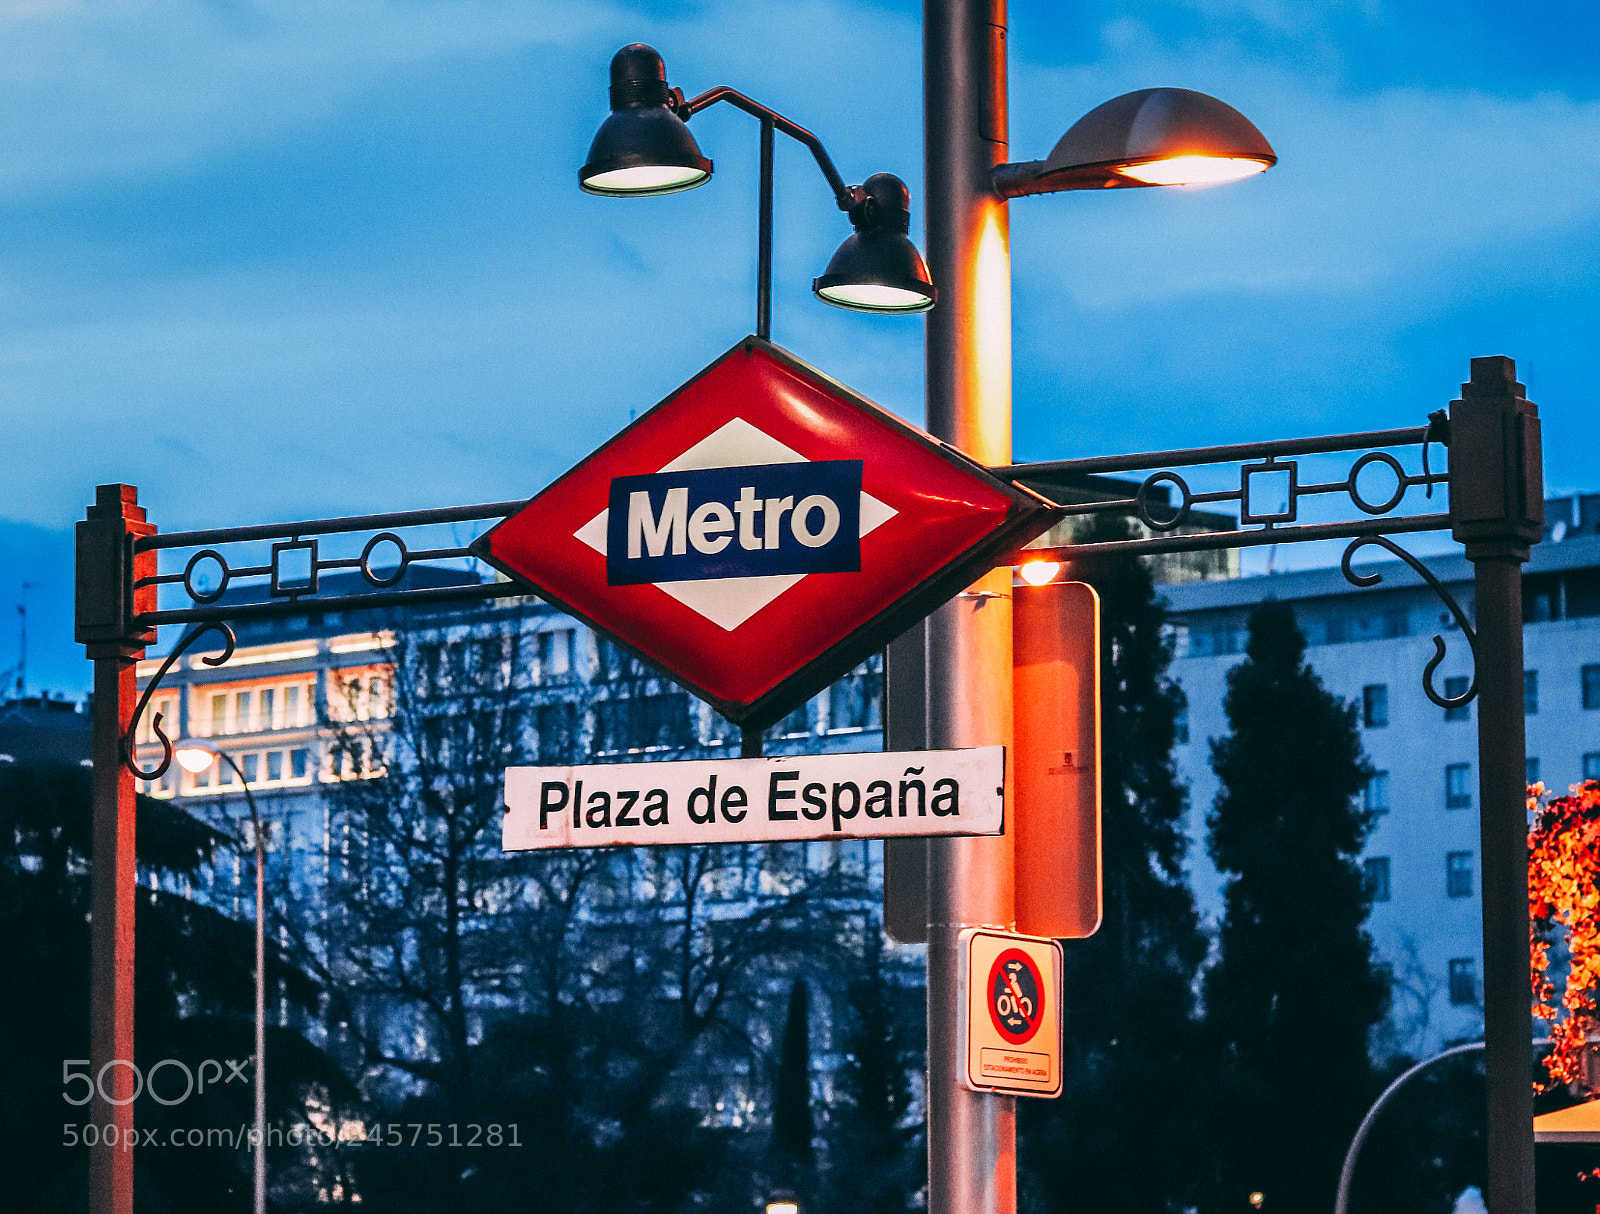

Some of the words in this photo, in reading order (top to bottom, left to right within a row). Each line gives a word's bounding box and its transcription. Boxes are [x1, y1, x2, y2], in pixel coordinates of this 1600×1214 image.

[627, 486, 841, 559] Metro
[539, 780, 669, 830] Plaza
[687, 774, 748, 824] de
[768, 766, 960, 831] España
